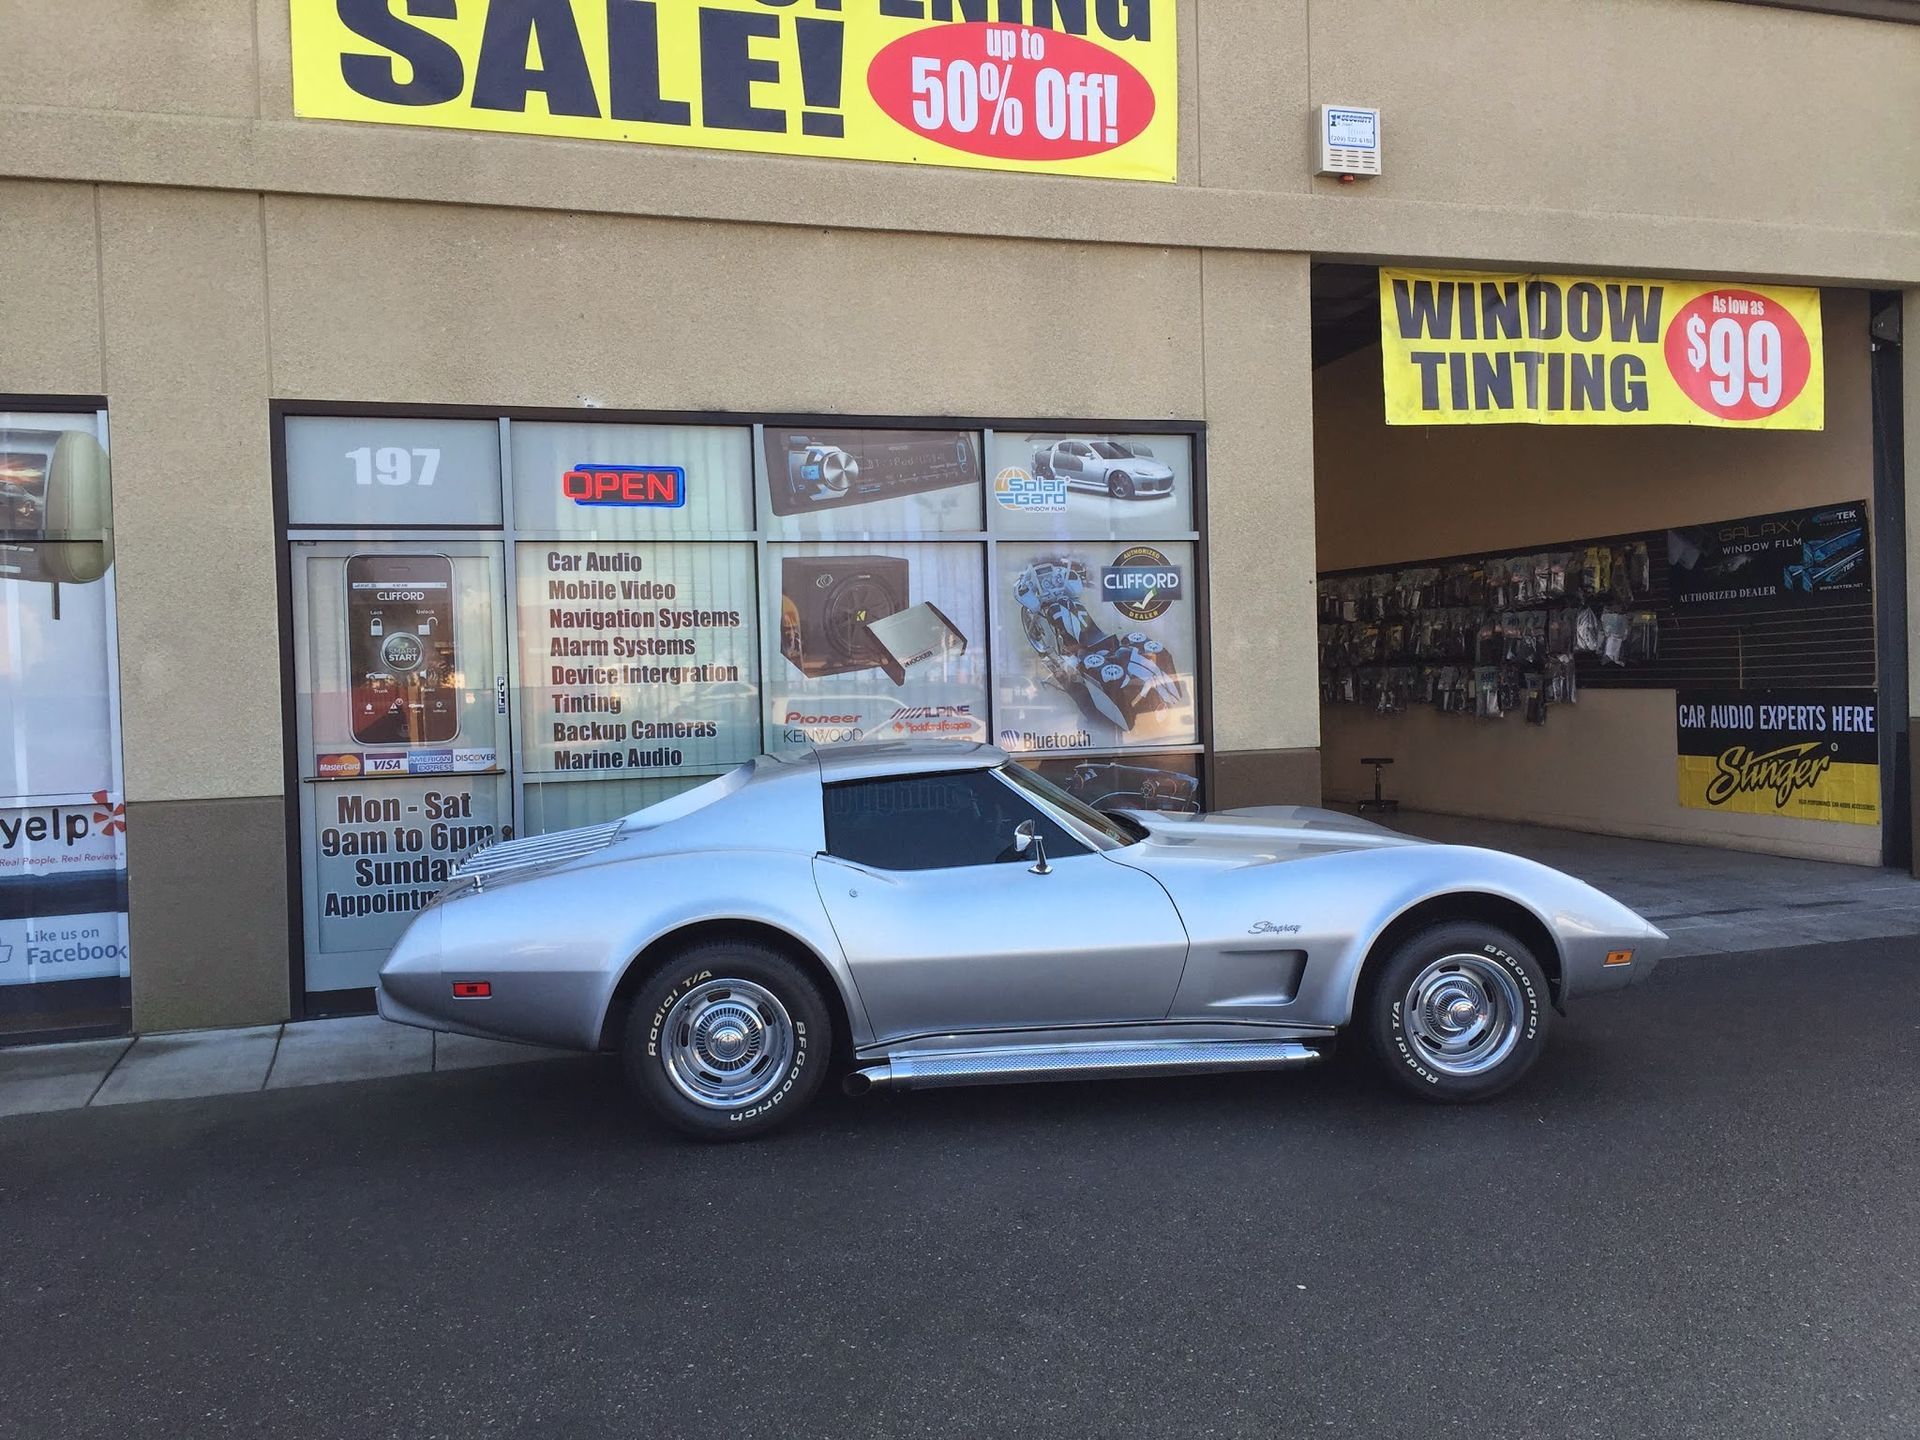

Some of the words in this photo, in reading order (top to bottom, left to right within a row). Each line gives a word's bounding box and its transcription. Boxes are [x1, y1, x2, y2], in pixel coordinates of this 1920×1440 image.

[986, 28, 1016, 60] up
[1021, 28, 1044, 60] to
[336, 0, 845, 138] SALE!
[911, 56, 1023, 136] 50%
[1035, 67, 1118, 143] Off!
[1392, 279, 1664, 344] WINDOW
[1712, 295, 1726, 313] As
[1728, 297, 1748, 315] low
[1749, 301, 1764, 316] as
[1686, 313, 1782, 407] $99
[1411, 351, 1649, 412] TINTING
[345, 447, 440, 485] 197
[563, 471, 674, 500] OPEN
[1009, 476, 1065, 491] Solar
[1015, 486, 1066, 504] Gard
[1719, 518, 1805, 542] GALAXY
[1123, 548, 1160, 559] AUTHORIZED
[1722, 541, 1770, 555] WINDOW
[1775, 537, 1802, 549] FILM
[547, 552, 581, 571] Car
[586, 552, 642, 571] Audio
[548, 580, 616, 600] Mobile
[620, 580, 676, 600] Video
[1103, 573, 1179, 589] CLIFFORD
[376, 591, 425, 601] CLIFFORD
[1679, 590, 1737, 603] AUTHORIZED
[1739, 586, 1776, 597] DEALER
[549, 608, 655, 630] Navigation
[659, 607, 740, 629] Systems
[1128, 610, 1159, 620] DEALER
[550, 637, 608, 656] Alarm
[613, 636, 696, 657] Systems
[388, 654, 418, 662] START
[551, 665, 618, 685] Device
[623, 664, 739, 685] Intergration
[551, 693, 622, 714] Tinting
[913, 705, 971, 719] ALPINE
[785, 712, 862, 724] Pioneer
[1679, 705, 1706, 728] CAR
[1710, 705, 1754, 729] AUDIO
[1760, 706, 1826, 731] EXPERTS
[1832, 706, 1875, 732] HERE
[553, 721, 626, 742] Backup
[631, 720, 717, 739] Cameras
[783, 728, 863, 743] KENWOOD
[1023, 730, 1091, 749] Bluetooth
[319, 762, 361, 771] MasterCard
[373, 760, 401, 770] VISA
[409, 755, 452, 764] AMERICAN
[417, 764, 454, 772] EXPRESS
[455, 753, 496, 762] DISCOVER
[554, 749, 623, 770] Marine
[627, 747, 682, 768] Audio
[1705, 741, 1832, 809] Stinger
[337, 795, 400, 824] Mon
[424, 791, 472, 820] Sat
[0, 808, 89, 849] yelp
[322, 828, 387, 857] 9am
[394, 827, 423, 853] to
[0, 858, 19, 867] Real
[23, 856, 58, 867] People.
[62, 854, 82, 863] Real
[26, 930, 57, 943] Like
[61, 929, 77, 940] us
[82, 928, 99, 939] on
[1484, 944, 1538, 1040] BFGoodrich
[648, 989, 678, 1056] Radial
[682, 969, 713, 988] T/A
[1392, 1001, 1401, 1030] T/A
[1395, 1036, 1440, 1084] Radial
[730, 1021, 807, 1122] BFGoodrich
